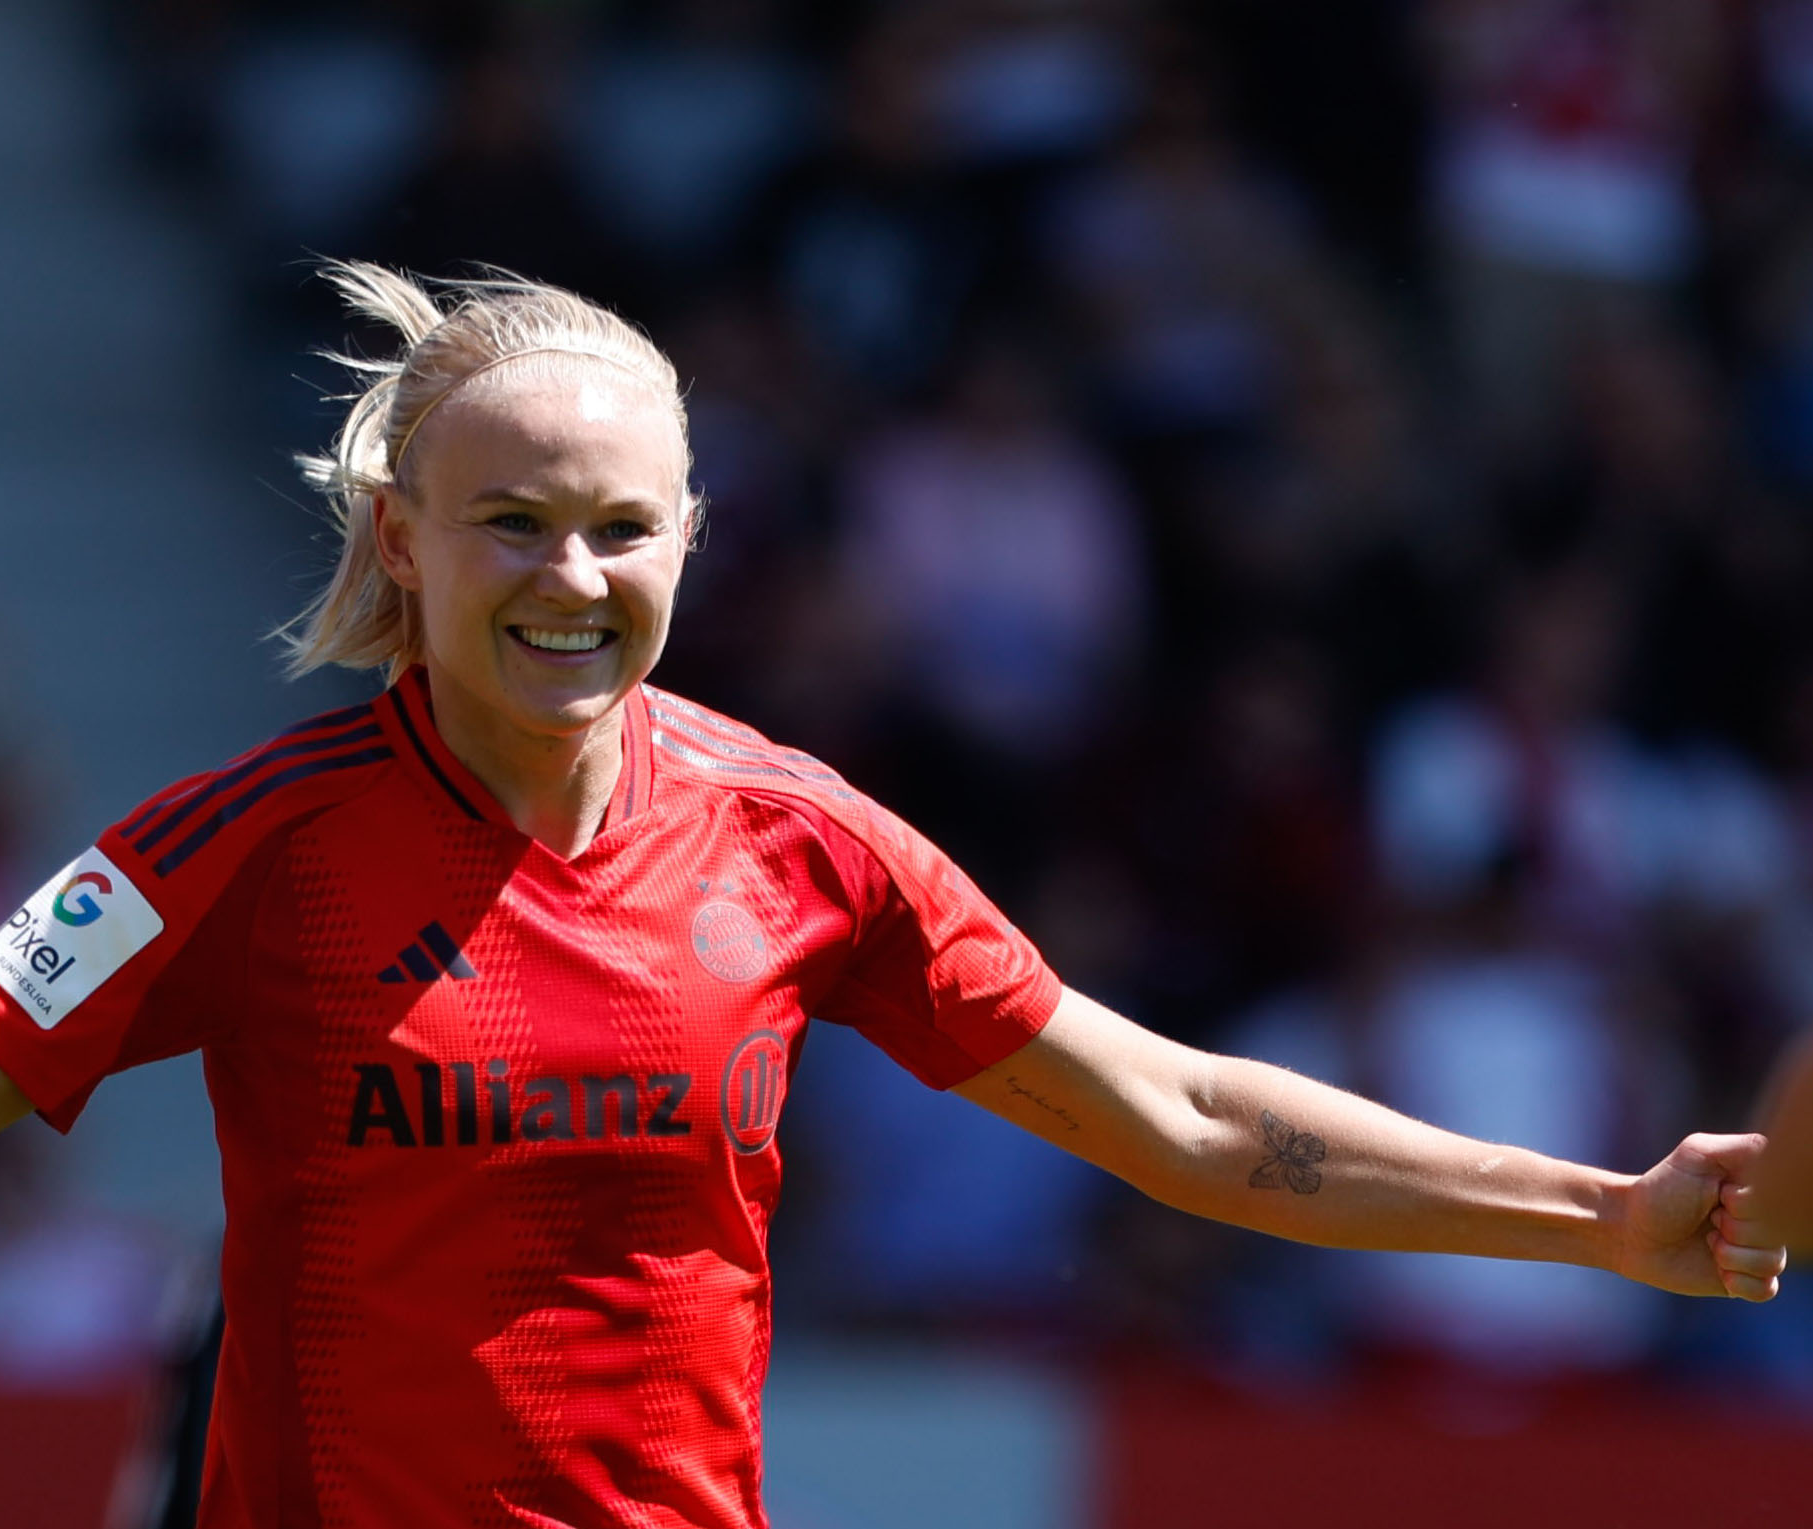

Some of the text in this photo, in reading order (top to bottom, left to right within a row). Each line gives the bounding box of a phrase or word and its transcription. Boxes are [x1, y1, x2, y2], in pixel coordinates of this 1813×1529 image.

[52, 871, 113, 927] G
[0, 907, 76, 984] Pixel
[347, 1058, 692, 1148] Allianz
